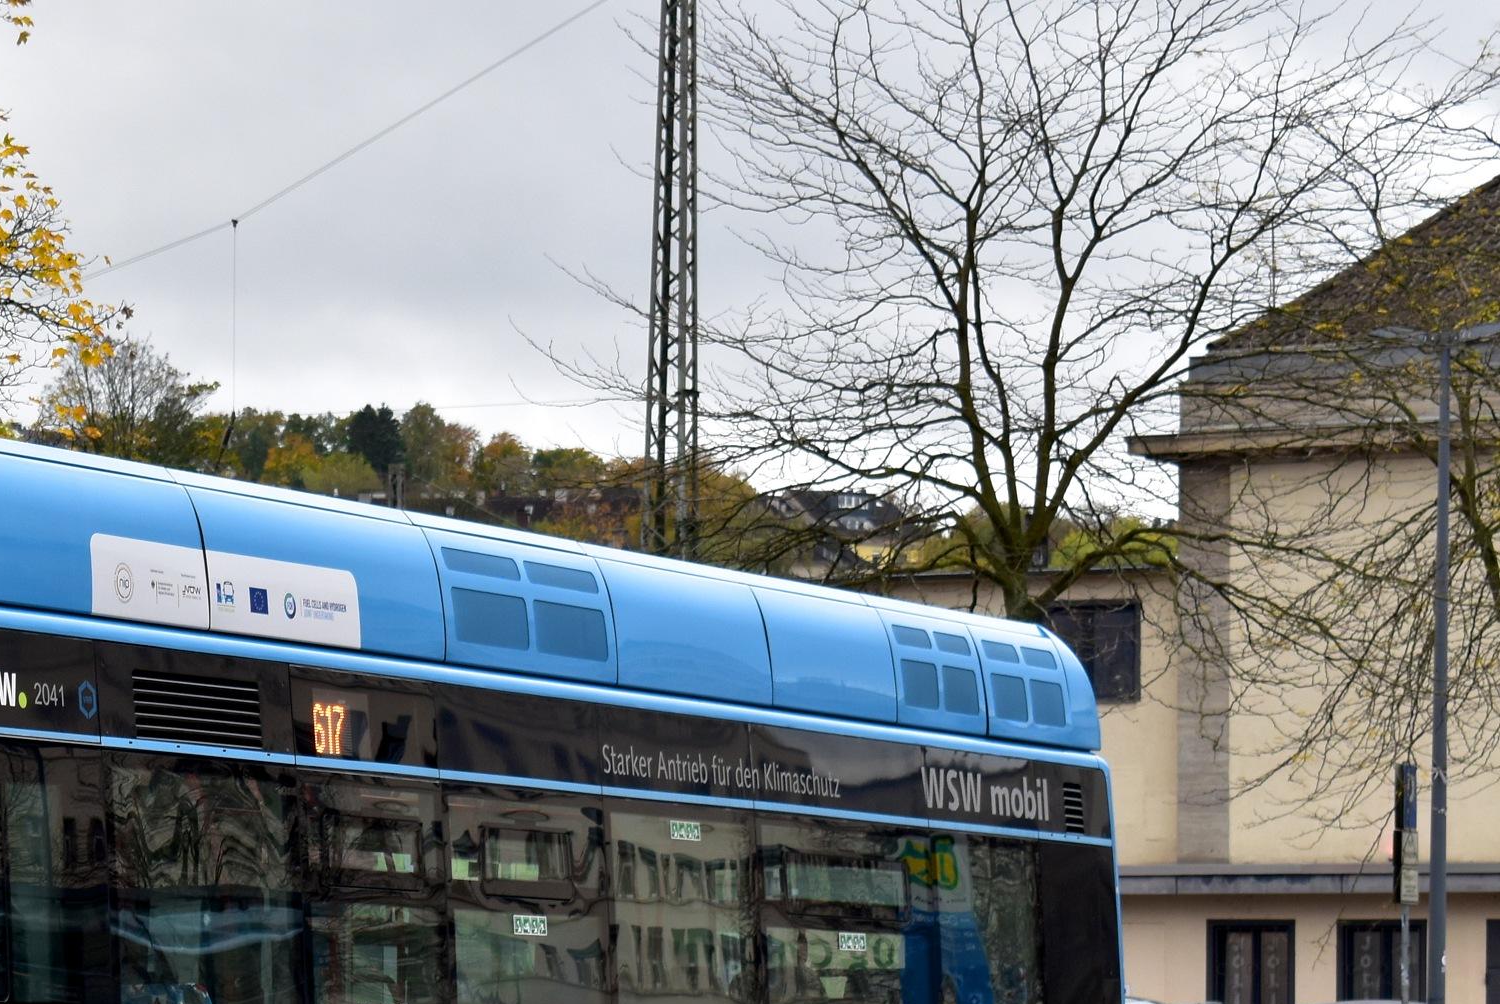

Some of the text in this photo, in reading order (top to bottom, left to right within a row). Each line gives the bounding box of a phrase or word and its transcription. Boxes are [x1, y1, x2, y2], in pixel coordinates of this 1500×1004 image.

[33, 681, 66, 708] 2041
[311, 703, 345, 755] 617
[602, 743, 841, 799] Starker Antrieb für den Klimaschutz
[920, 766, 1050, 822] WSW mobil
